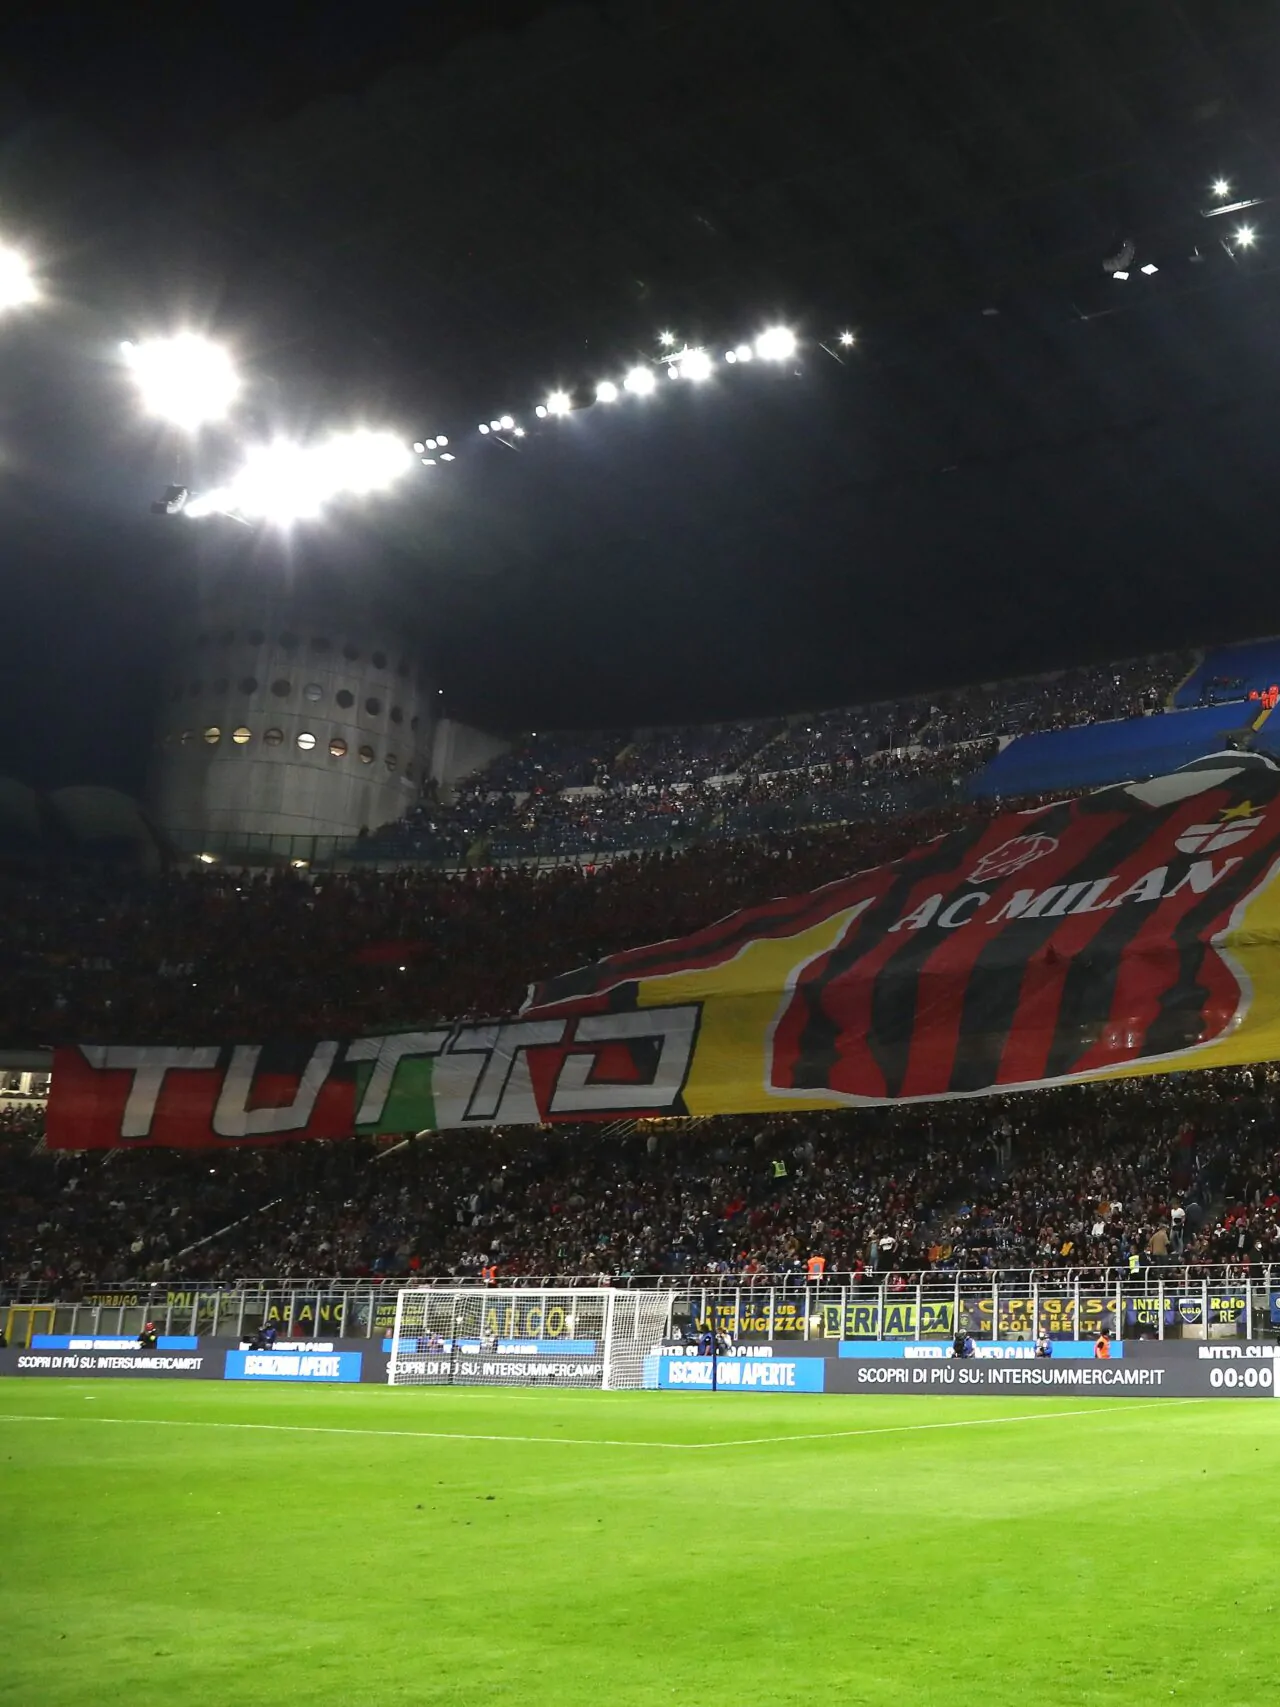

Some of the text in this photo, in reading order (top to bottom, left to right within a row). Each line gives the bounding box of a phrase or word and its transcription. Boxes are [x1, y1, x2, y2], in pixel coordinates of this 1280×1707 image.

[888, 857, 1244, 932] AC MILAN
[79, 1005, 701, 1138] TUTTO
[1132, 1298, 1171, 1310] INTER
[1210, 1297, 1246, 1310] Rolo
[826, 1304, 951, 1334] BERNALDA
[1219, 1310, 1236, 1323] RE
[18, 1354, 204, 1370] SCOPRI DI PIÙ SU: INTERSUMMERCAMP.IT
[744, 1362, 796, 1386] APERTE
[857, 1365, 1165, 1385] SCOPRI DI PIÙ SU: INTERSUMMERCAMP.IT
[1209, 1367, 1273, 1388] 00:00
